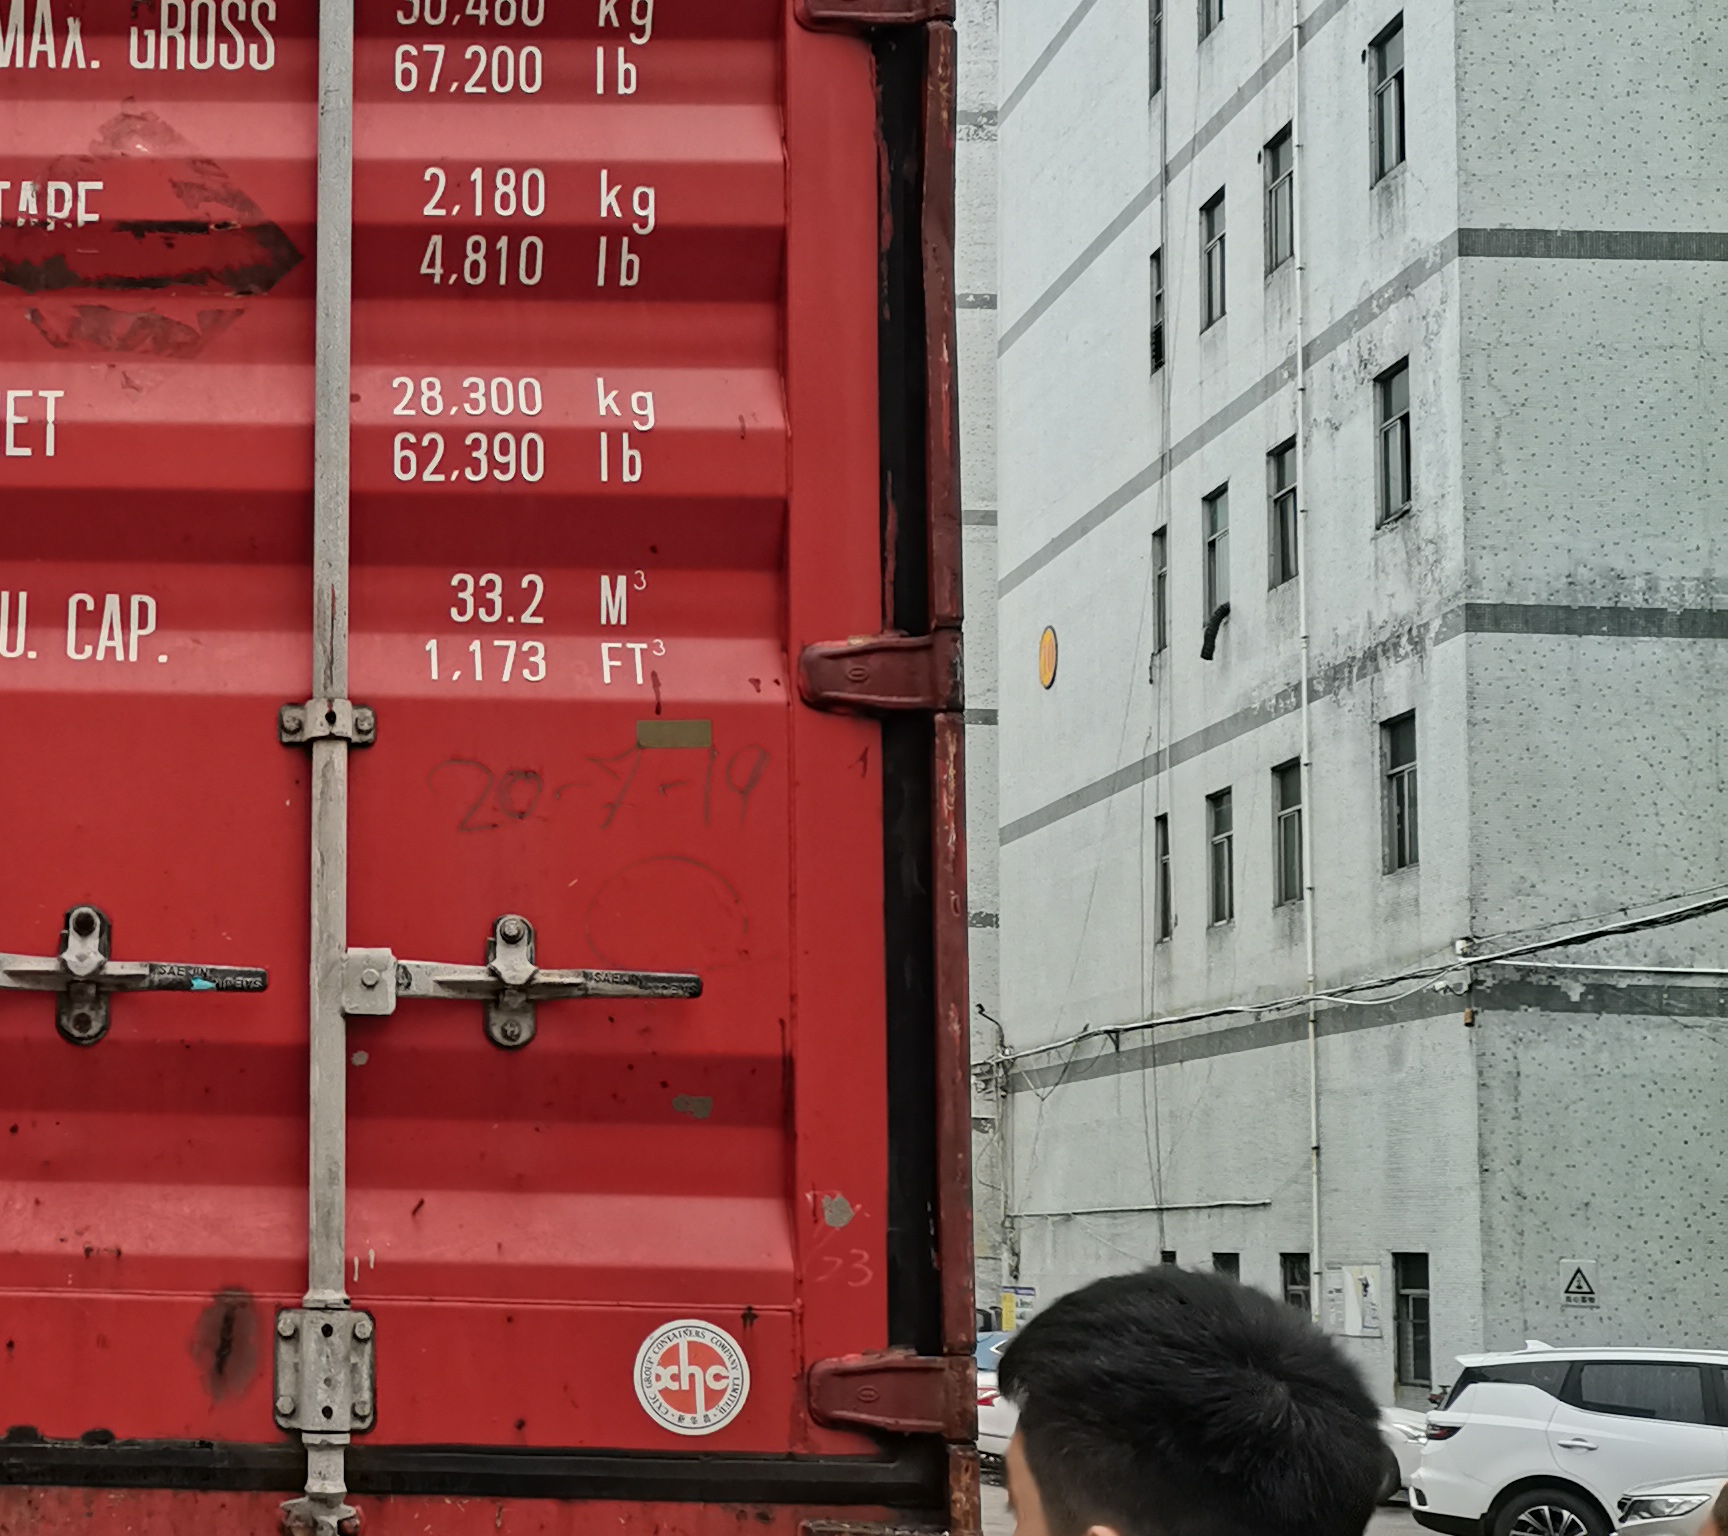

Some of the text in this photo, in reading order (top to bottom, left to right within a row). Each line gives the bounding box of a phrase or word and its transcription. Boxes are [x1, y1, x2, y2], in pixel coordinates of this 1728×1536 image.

[394, 44, 637, 95] 67,200 lb
[423, 167, 546, 217] 2,180
[600, 169, 655, 235] kg
[420, 234, 640, 286] 4,810 lb
[392, 377, 543, 416] 28,300
[596, 377, 655, 431] kg
[393, 432, 642, 483] 62,390 lb
[66, 593, 169, 663] CAP.
[450, 572, 545, 624] 33.2
[425, 638, 547, 682] 1,173
[652, 1328, 706, 1355] CONTAINERS
[710, 1336, 739, 1371] COMPANY
[643, 1356, 654, 1390] GROUP
[716, 1376, 741, 1415] LIMITED
